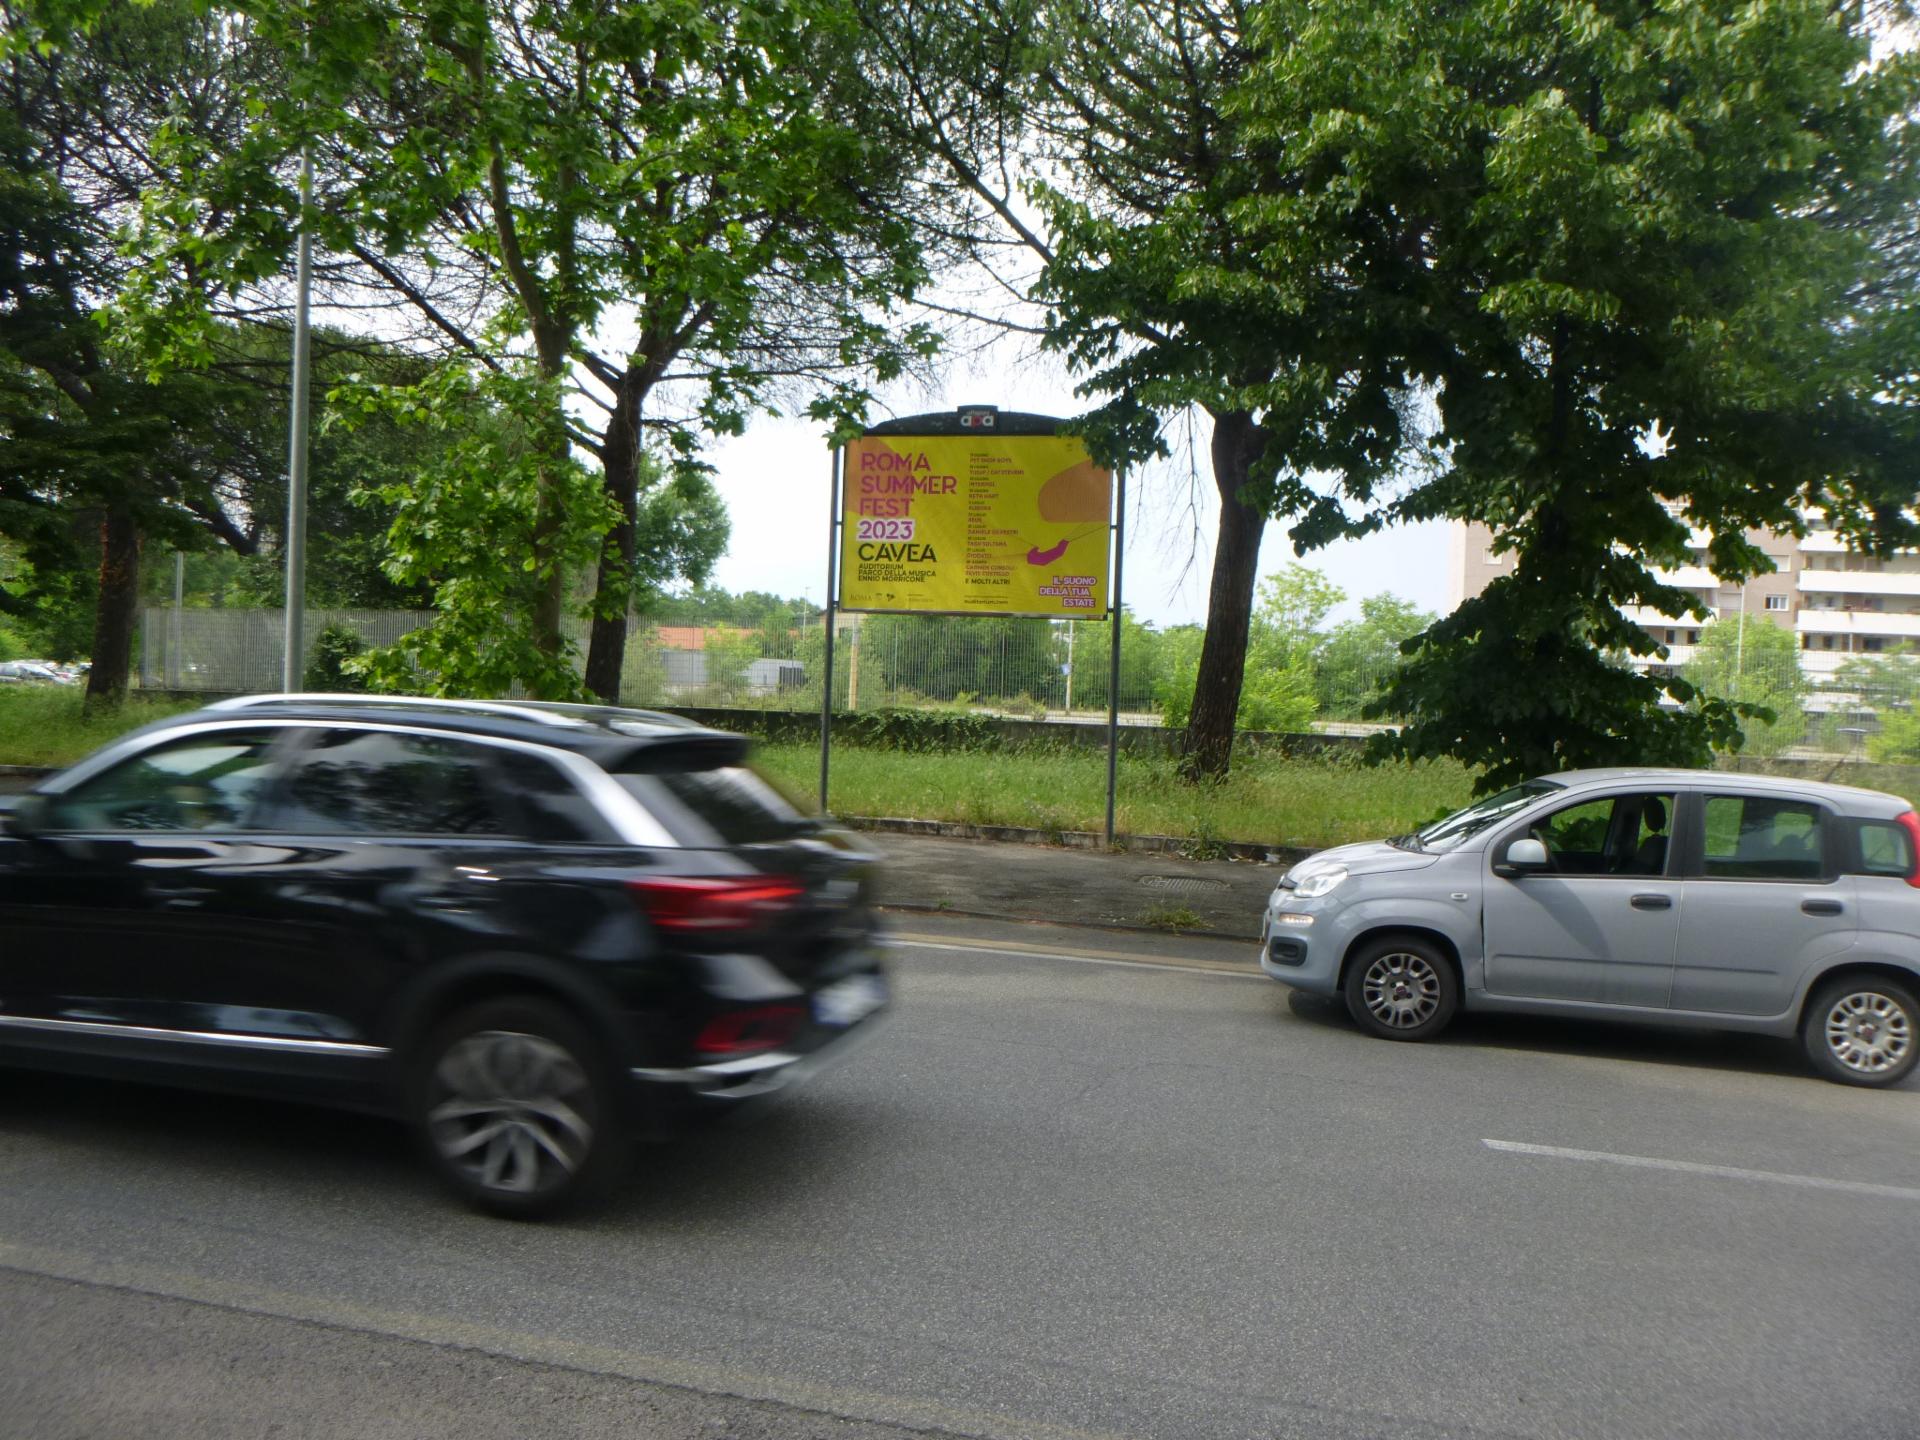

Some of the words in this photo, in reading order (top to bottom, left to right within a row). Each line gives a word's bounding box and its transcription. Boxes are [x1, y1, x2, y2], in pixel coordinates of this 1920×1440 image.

[861, 452, 931, 472] ROMA
[861, 476, 957, 495] SUMMER
[860, 498, 914, 516] FEST
[858, 520, 912, 540] 2023
[858, 543, 938, 562] CAVEA
[1053, 576, 1061, 585] IL
[1063, 576, 1096, 585] SUONO
[1040, 587, 1068, 596] DELLA
[1072, 588, 1090, 596] TUA
[1063, 598, 1095, 607] ESTATE
